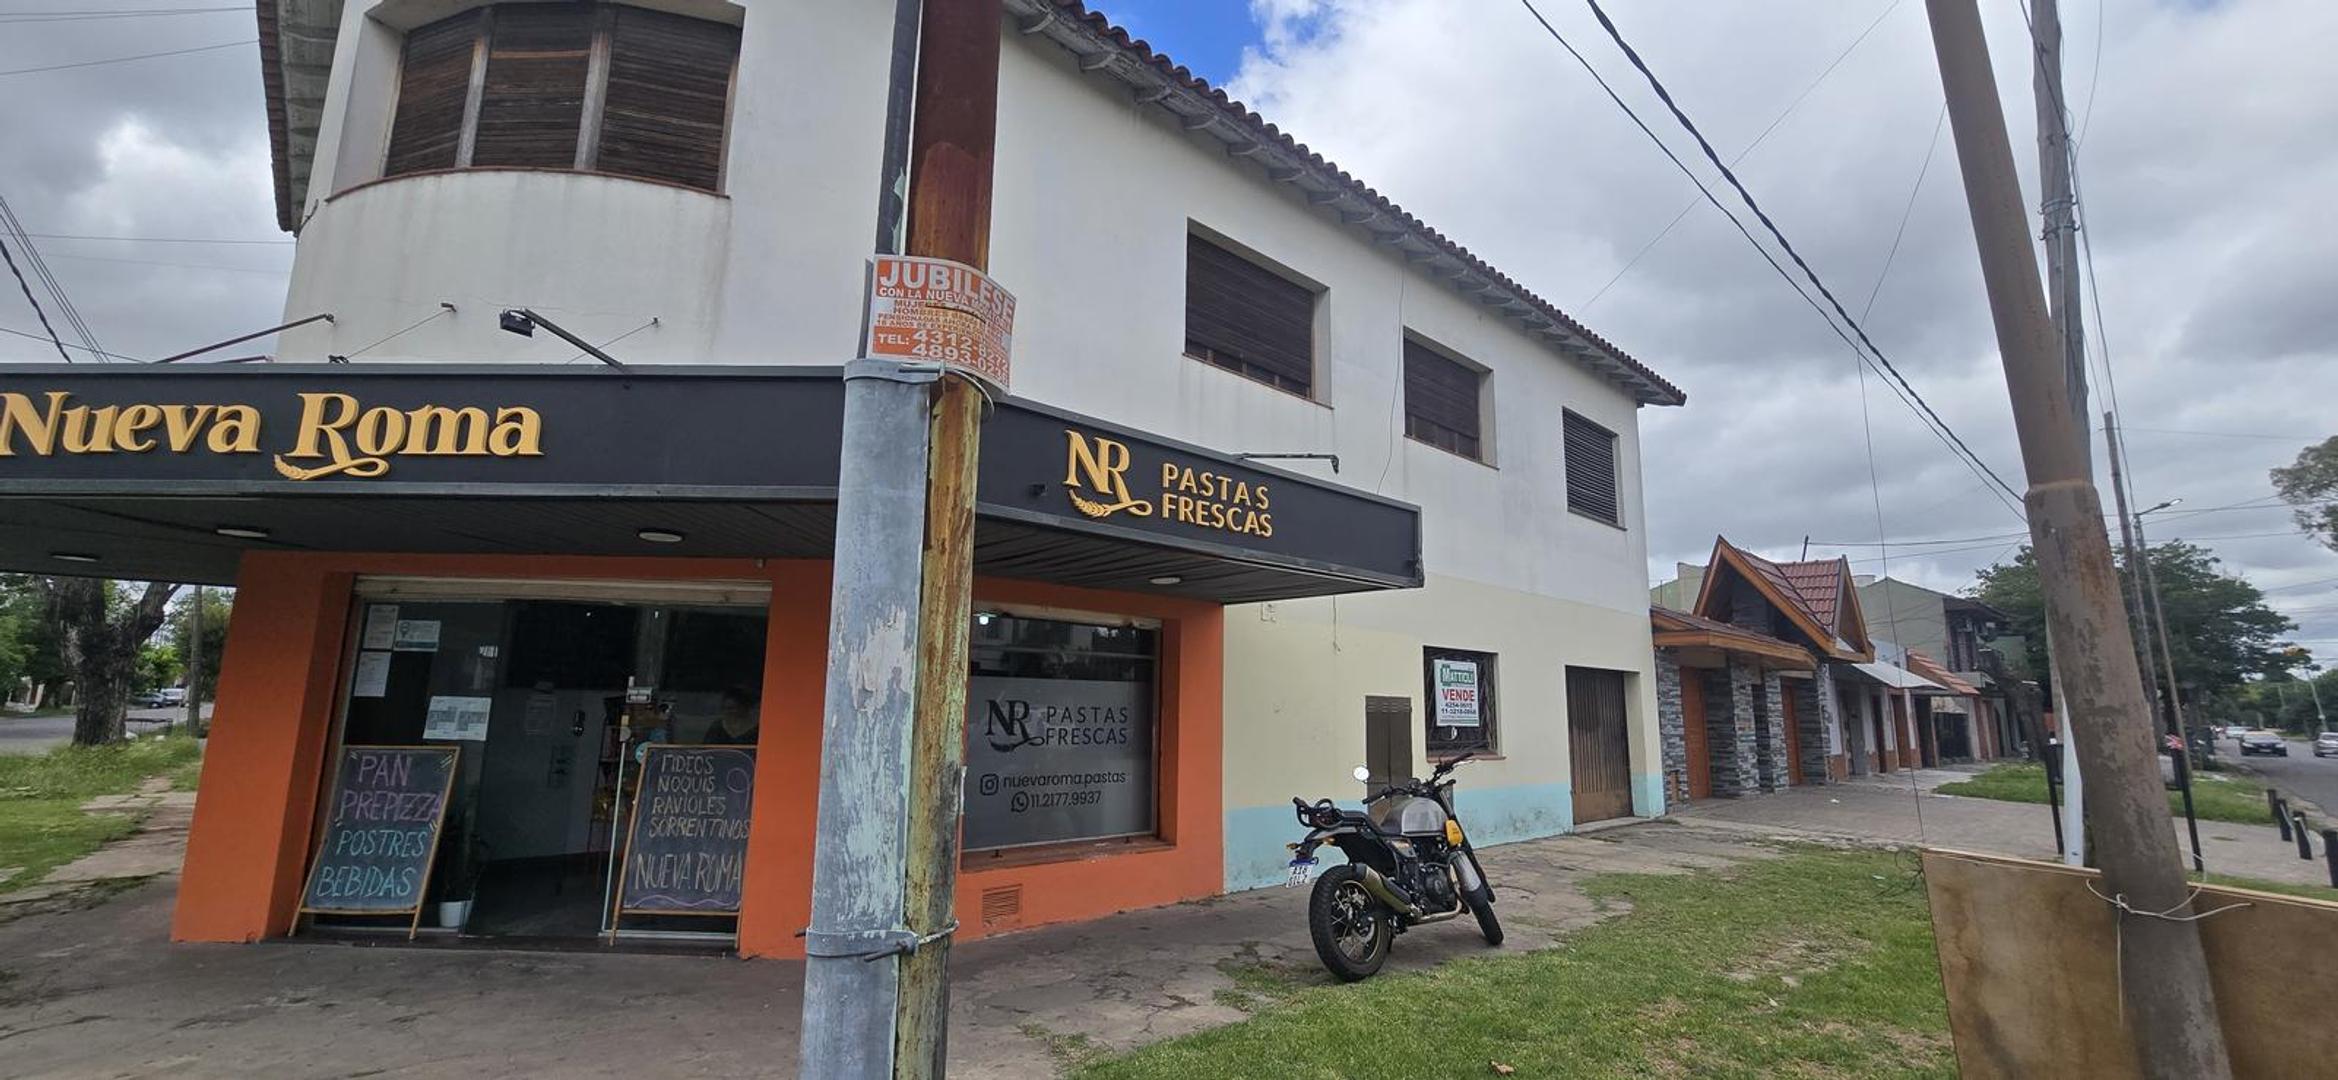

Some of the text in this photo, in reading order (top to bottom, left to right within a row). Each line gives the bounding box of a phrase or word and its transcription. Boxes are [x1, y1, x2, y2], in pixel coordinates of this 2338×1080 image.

[880, 262, 1015, 321] JUBILESE
[880, 287, 905, 297] CON
[908, 289, 922, 299] LA
[926, 290, 968, 306] NUEVA
[878, 333, 909, 345] TEL:
[0, 391, 544, 480] Nueva Roma
[1063, 429, 1152, 518] NR
[1161, 463, 1270, 510] PASTAS
[1161, 493, 1273, 538] FRESCAS
[1441, 689, 1475, 701] VENDE
[985, 700, 1045, 752] NR
[1046, 706, 1128, 724] PASTAS
[1046, 727, 1128, 745] FRESCAS
[358, 754, 413, 787] PAN
[1003, 770, 1126, 790] nuevaroma.pastas
[339, 790, 444, 822] PREPIZZA
[652, 796, 727, 816] RAVIOLES
[1031, 790, 1102, 809] 11.2177.9937
[336, 829, 428, 858] POSTRES
[316, 866, 417, 898] BEBIDAS
[634, 851, 742, 893] NUEVA ROMA
